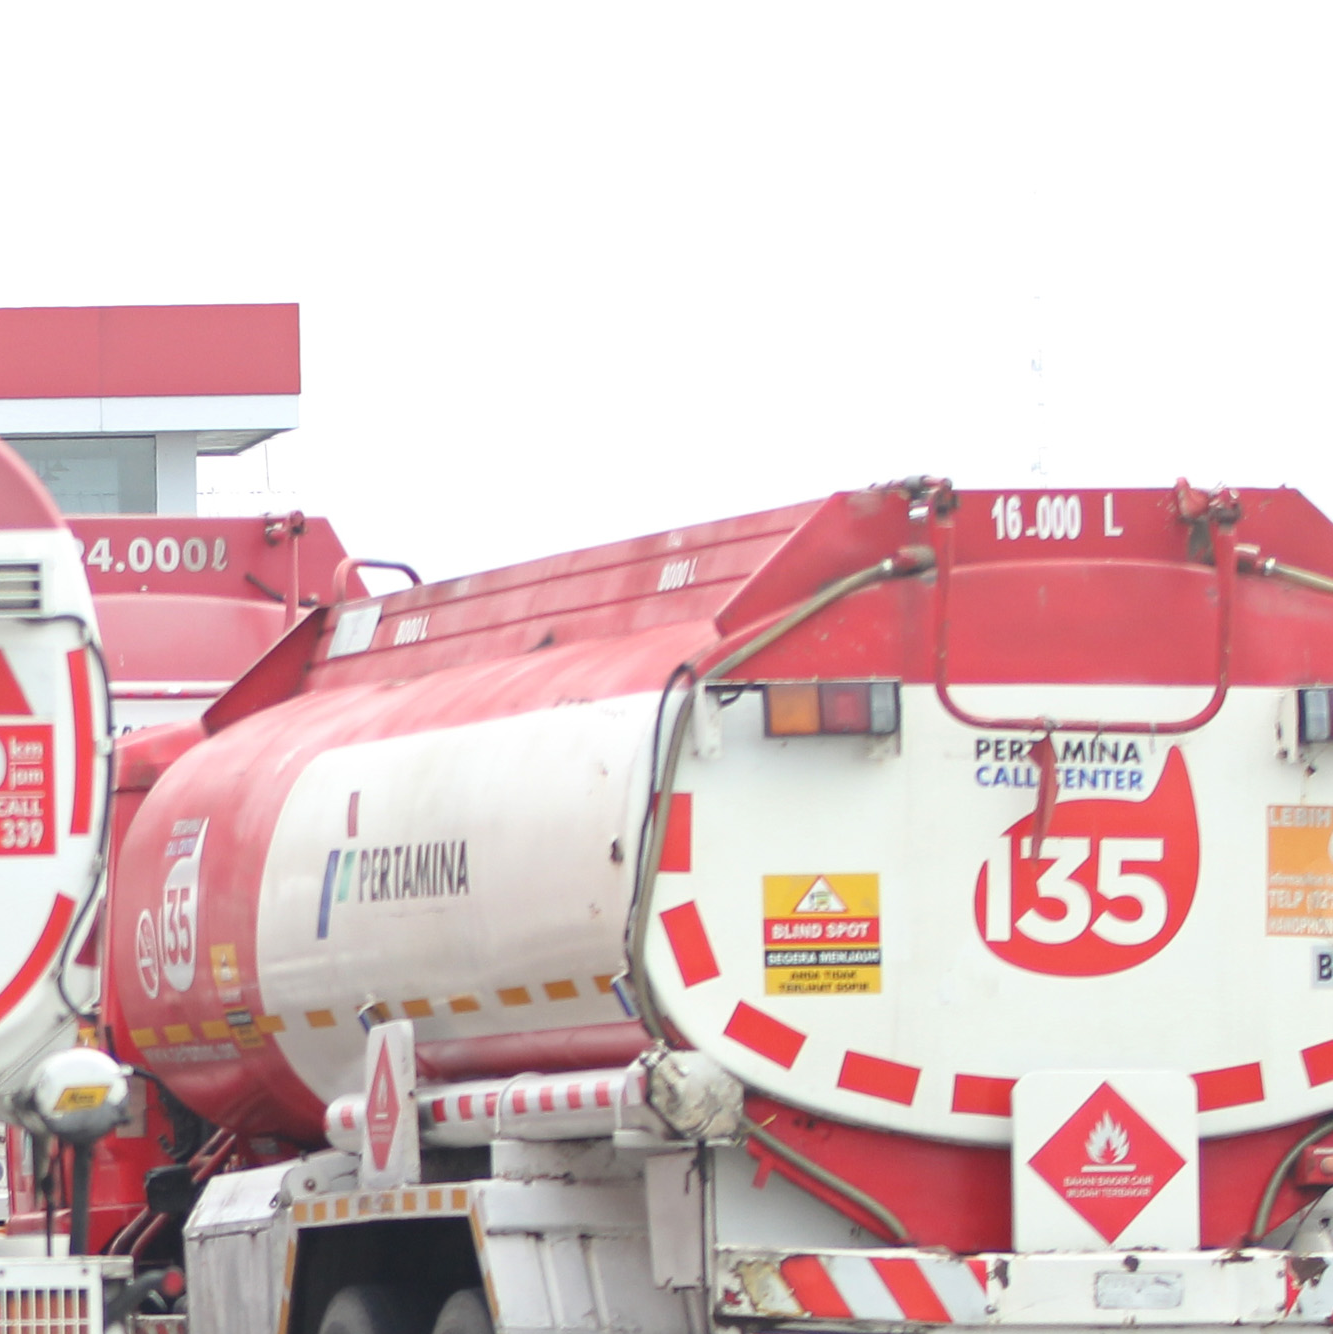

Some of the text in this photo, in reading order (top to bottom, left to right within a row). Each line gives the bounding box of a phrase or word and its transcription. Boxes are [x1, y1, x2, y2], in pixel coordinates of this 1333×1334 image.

[991, 492, 1124, 540] 16.000 L
[974, 738, 1142, 764] PERMINA
[974, 766, 1144, 790] CALL ENTER
[0, 819, 45, 849] 339
[358, 840, 470, 903] PERTAMINA
[986, 835, 1169, 947] 135
[771, 921, 871, 940] BLIND SPOT
